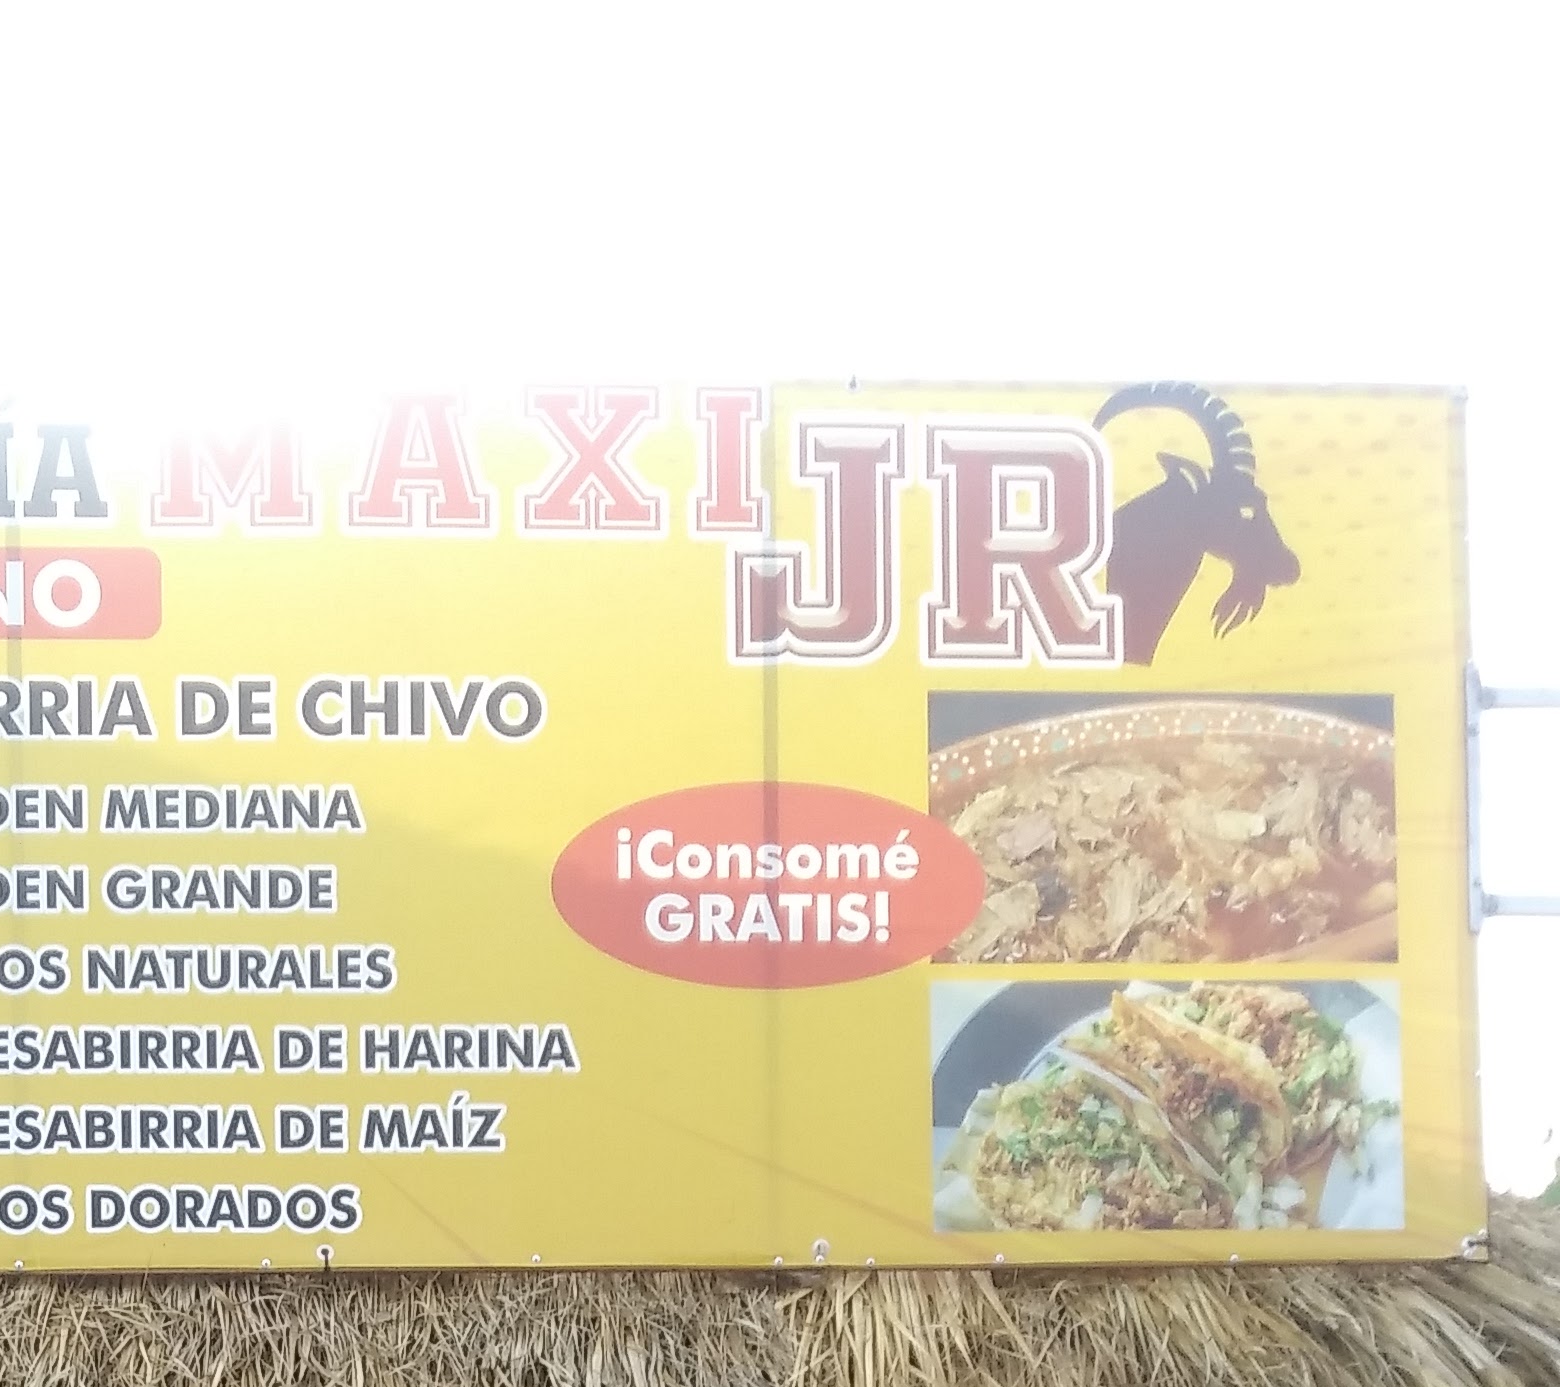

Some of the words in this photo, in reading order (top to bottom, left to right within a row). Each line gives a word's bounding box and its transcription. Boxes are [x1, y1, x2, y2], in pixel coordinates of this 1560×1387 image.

[150, 386, 764, 532] MAXI
[735, 422, 1124, 661] JR
[180, 681, 272, 736] DE
[301, 680, 544, 738] CHIVO
[105, 788, 362, 830] MEDIANA
[106, 868, 336, 911] GRANDE
[644, 890, 892, 943] GRATIS!
[87, 947, 393, 990] NATURALES
[278, 1028, 342, 1070] DE
[363, 1028, 576, 1070] HARINA
[279, 1108, 344, 1150] DE
[363, 1093, 503, 1150] MAÍZ
[90, 1187, 358, 1230] DORADOS
